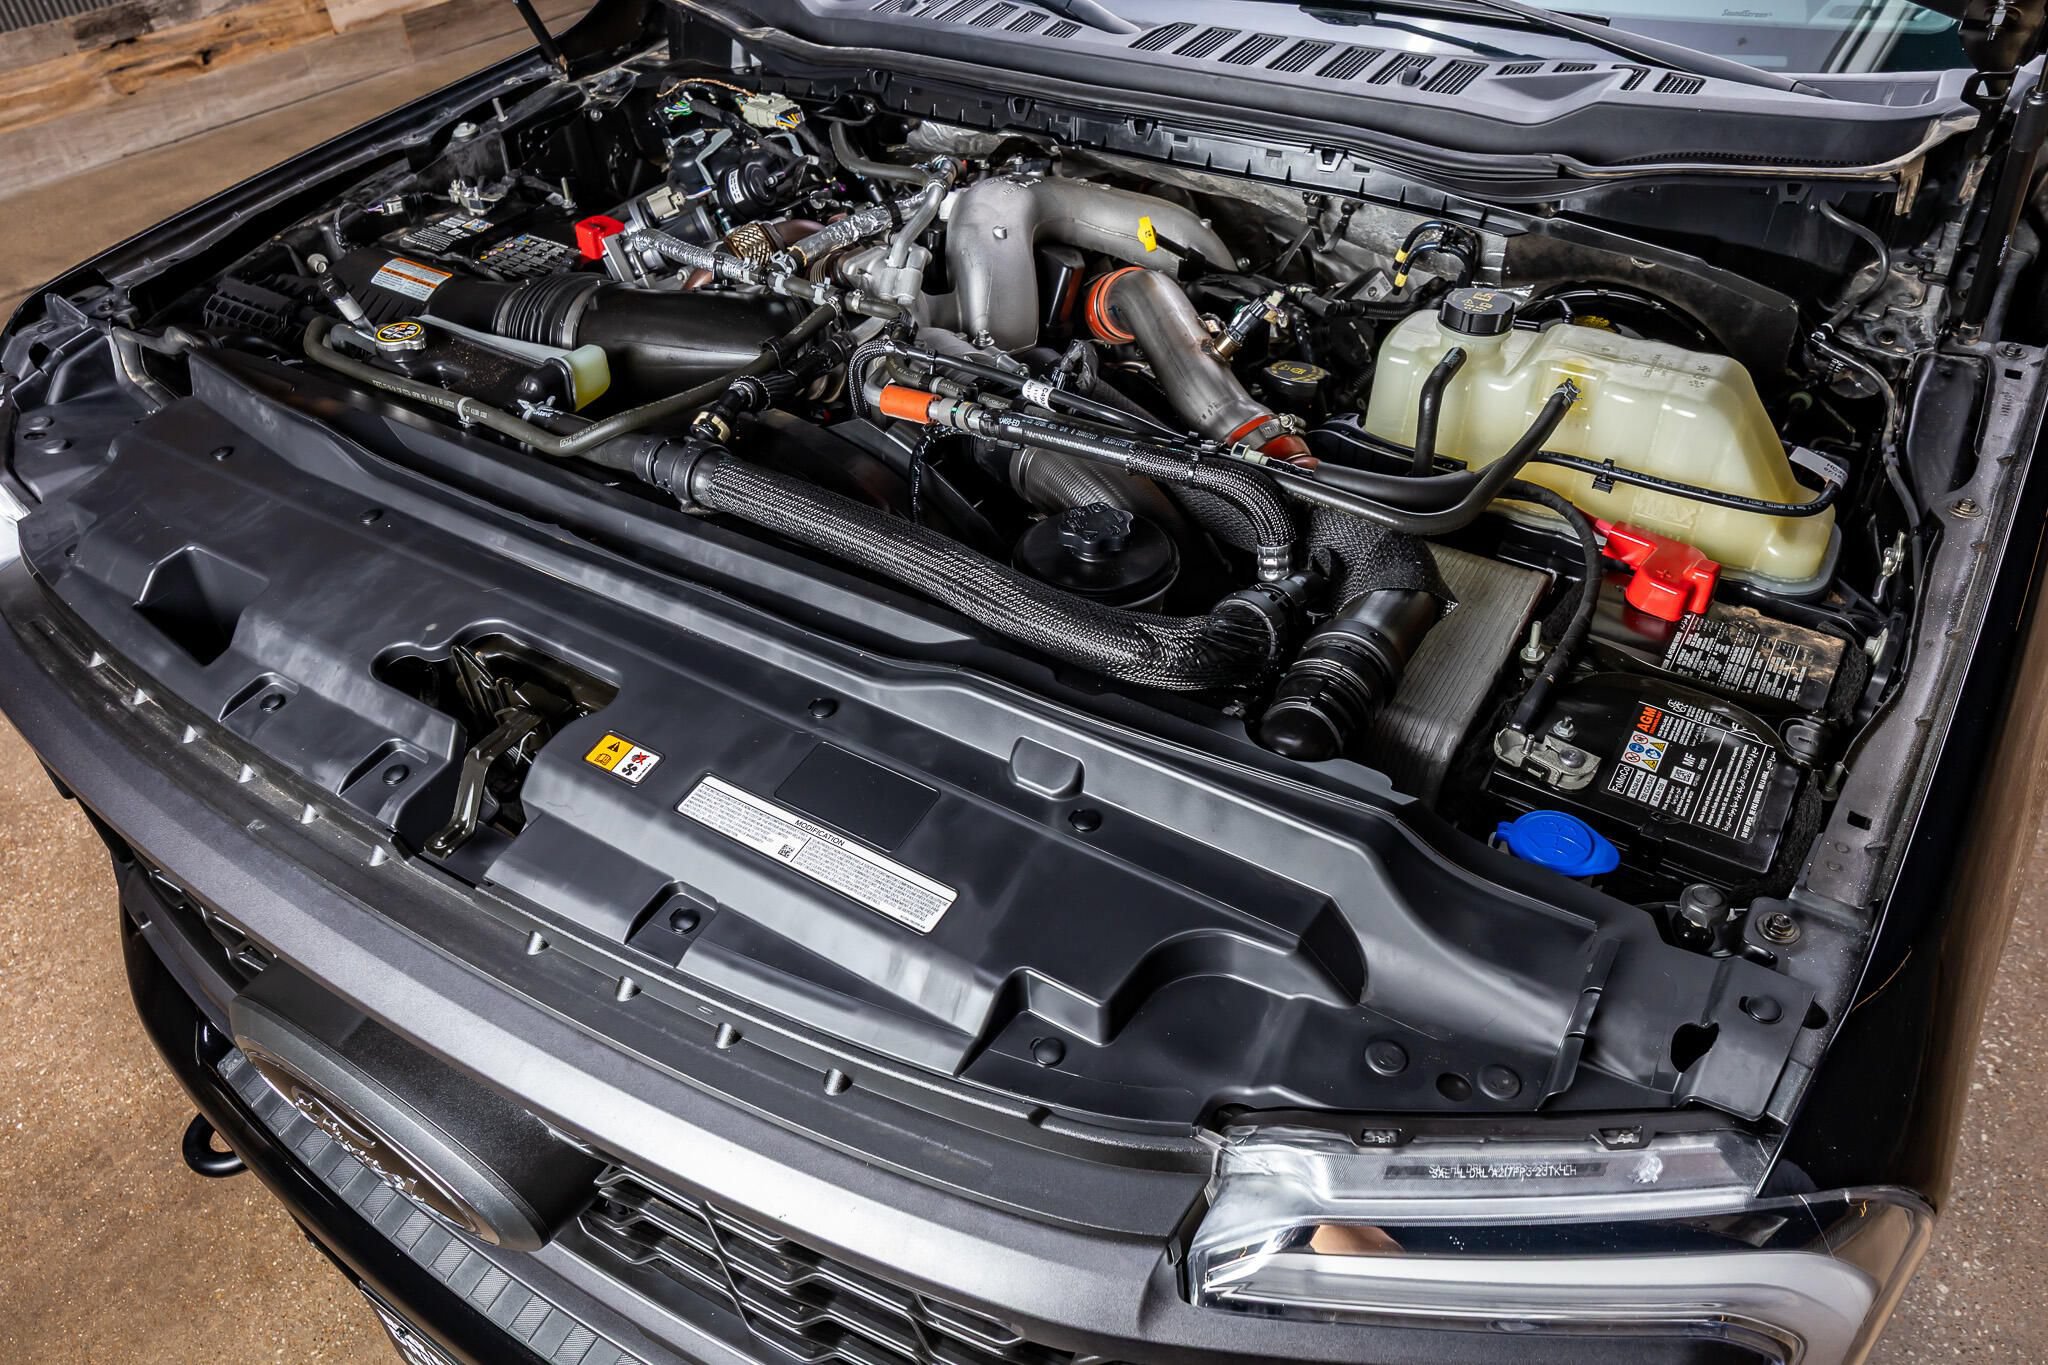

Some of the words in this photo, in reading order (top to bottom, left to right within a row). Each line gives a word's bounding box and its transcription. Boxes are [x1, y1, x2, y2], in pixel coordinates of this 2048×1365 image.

[1636, 705, 1656, 732] AGM
[1681, 752, 1696, 767] MF
[1611, 765, 1630, 791] FoMoCo
[795, 819, 846, 846] MODIFICATION
